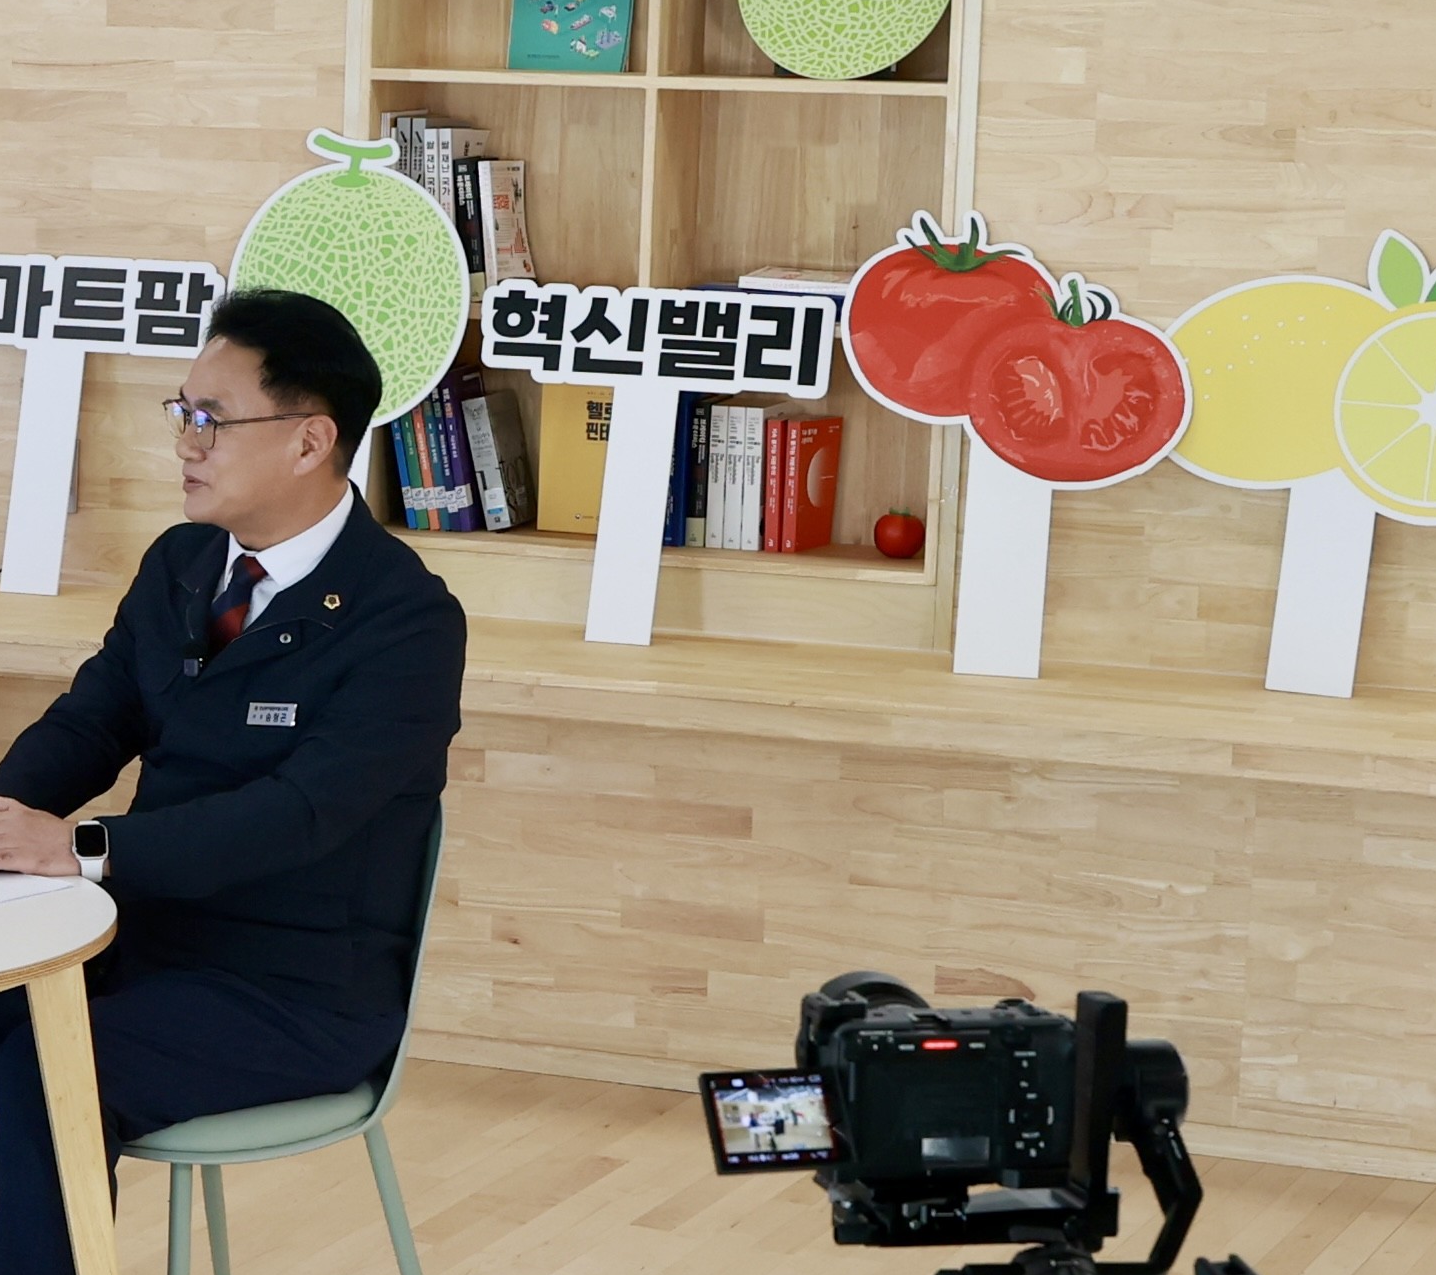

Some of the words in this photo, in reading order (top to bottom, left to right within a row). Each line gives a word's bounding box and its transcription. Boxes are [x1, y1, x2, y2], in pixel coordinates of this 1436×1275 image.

[426, 154, 435, 173] 재난
[441, 154, 450, 173] 재난
[441, 177, 450, 196] 국가
[492, 290, 824, 386] 혁신밸리
